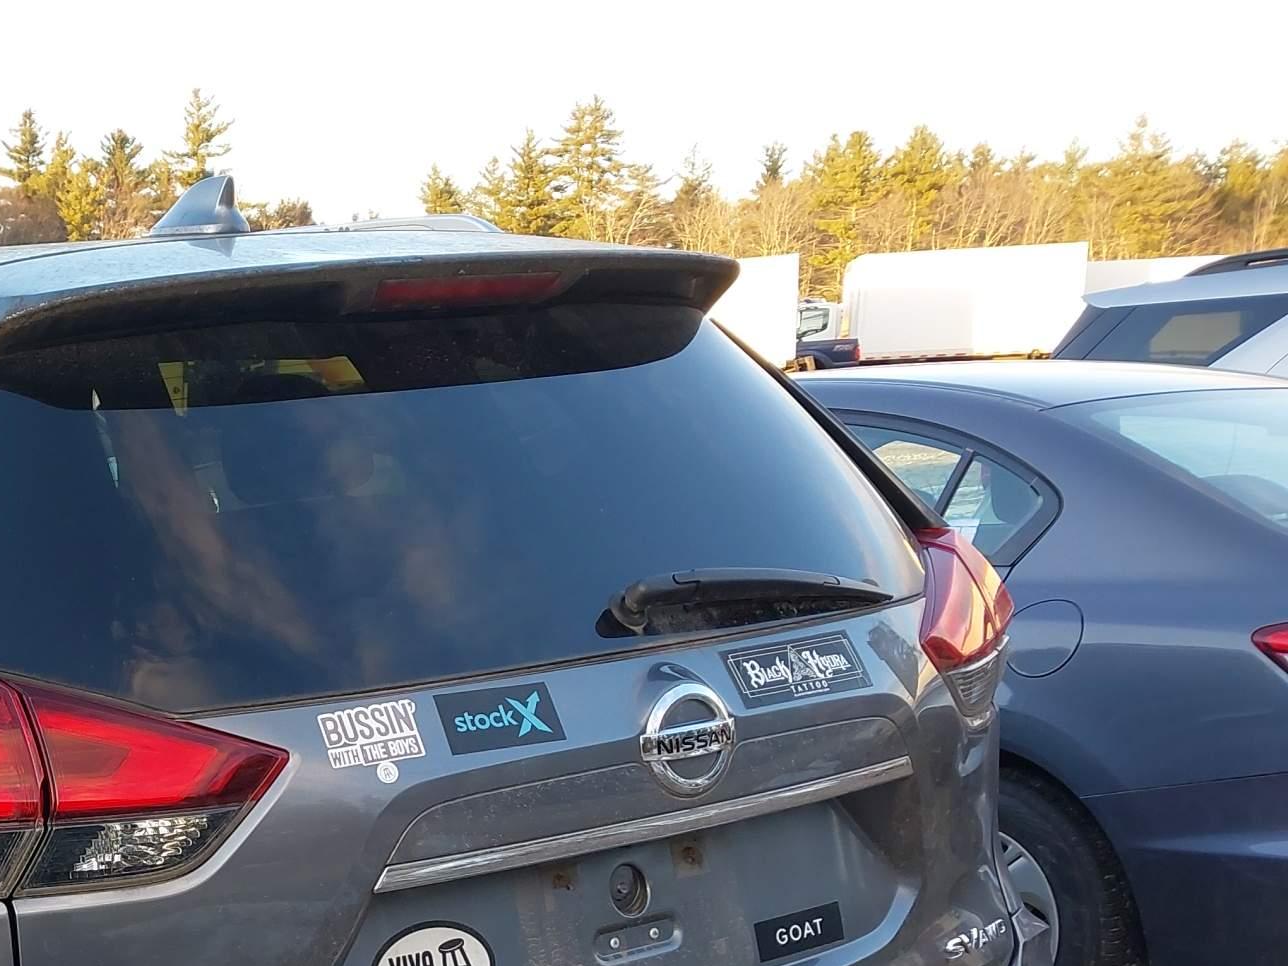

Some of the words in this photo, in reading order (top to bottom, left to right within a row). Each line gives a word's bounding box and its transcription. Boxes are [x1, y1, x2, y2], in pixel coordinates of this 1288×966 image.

[790, 680, 829, 693] TATTOO
[320, 702, 415, 746] BUSSIN'
[454, 691, 554, 737] stockX
[330, 746, 362, 767] WITH
[364, 742, 388, 760] THE
[387, 738, 419, 757] BOYS
[657, 726, 731, 755] NISSAN
[775, 917, 824, 946] GOAT
